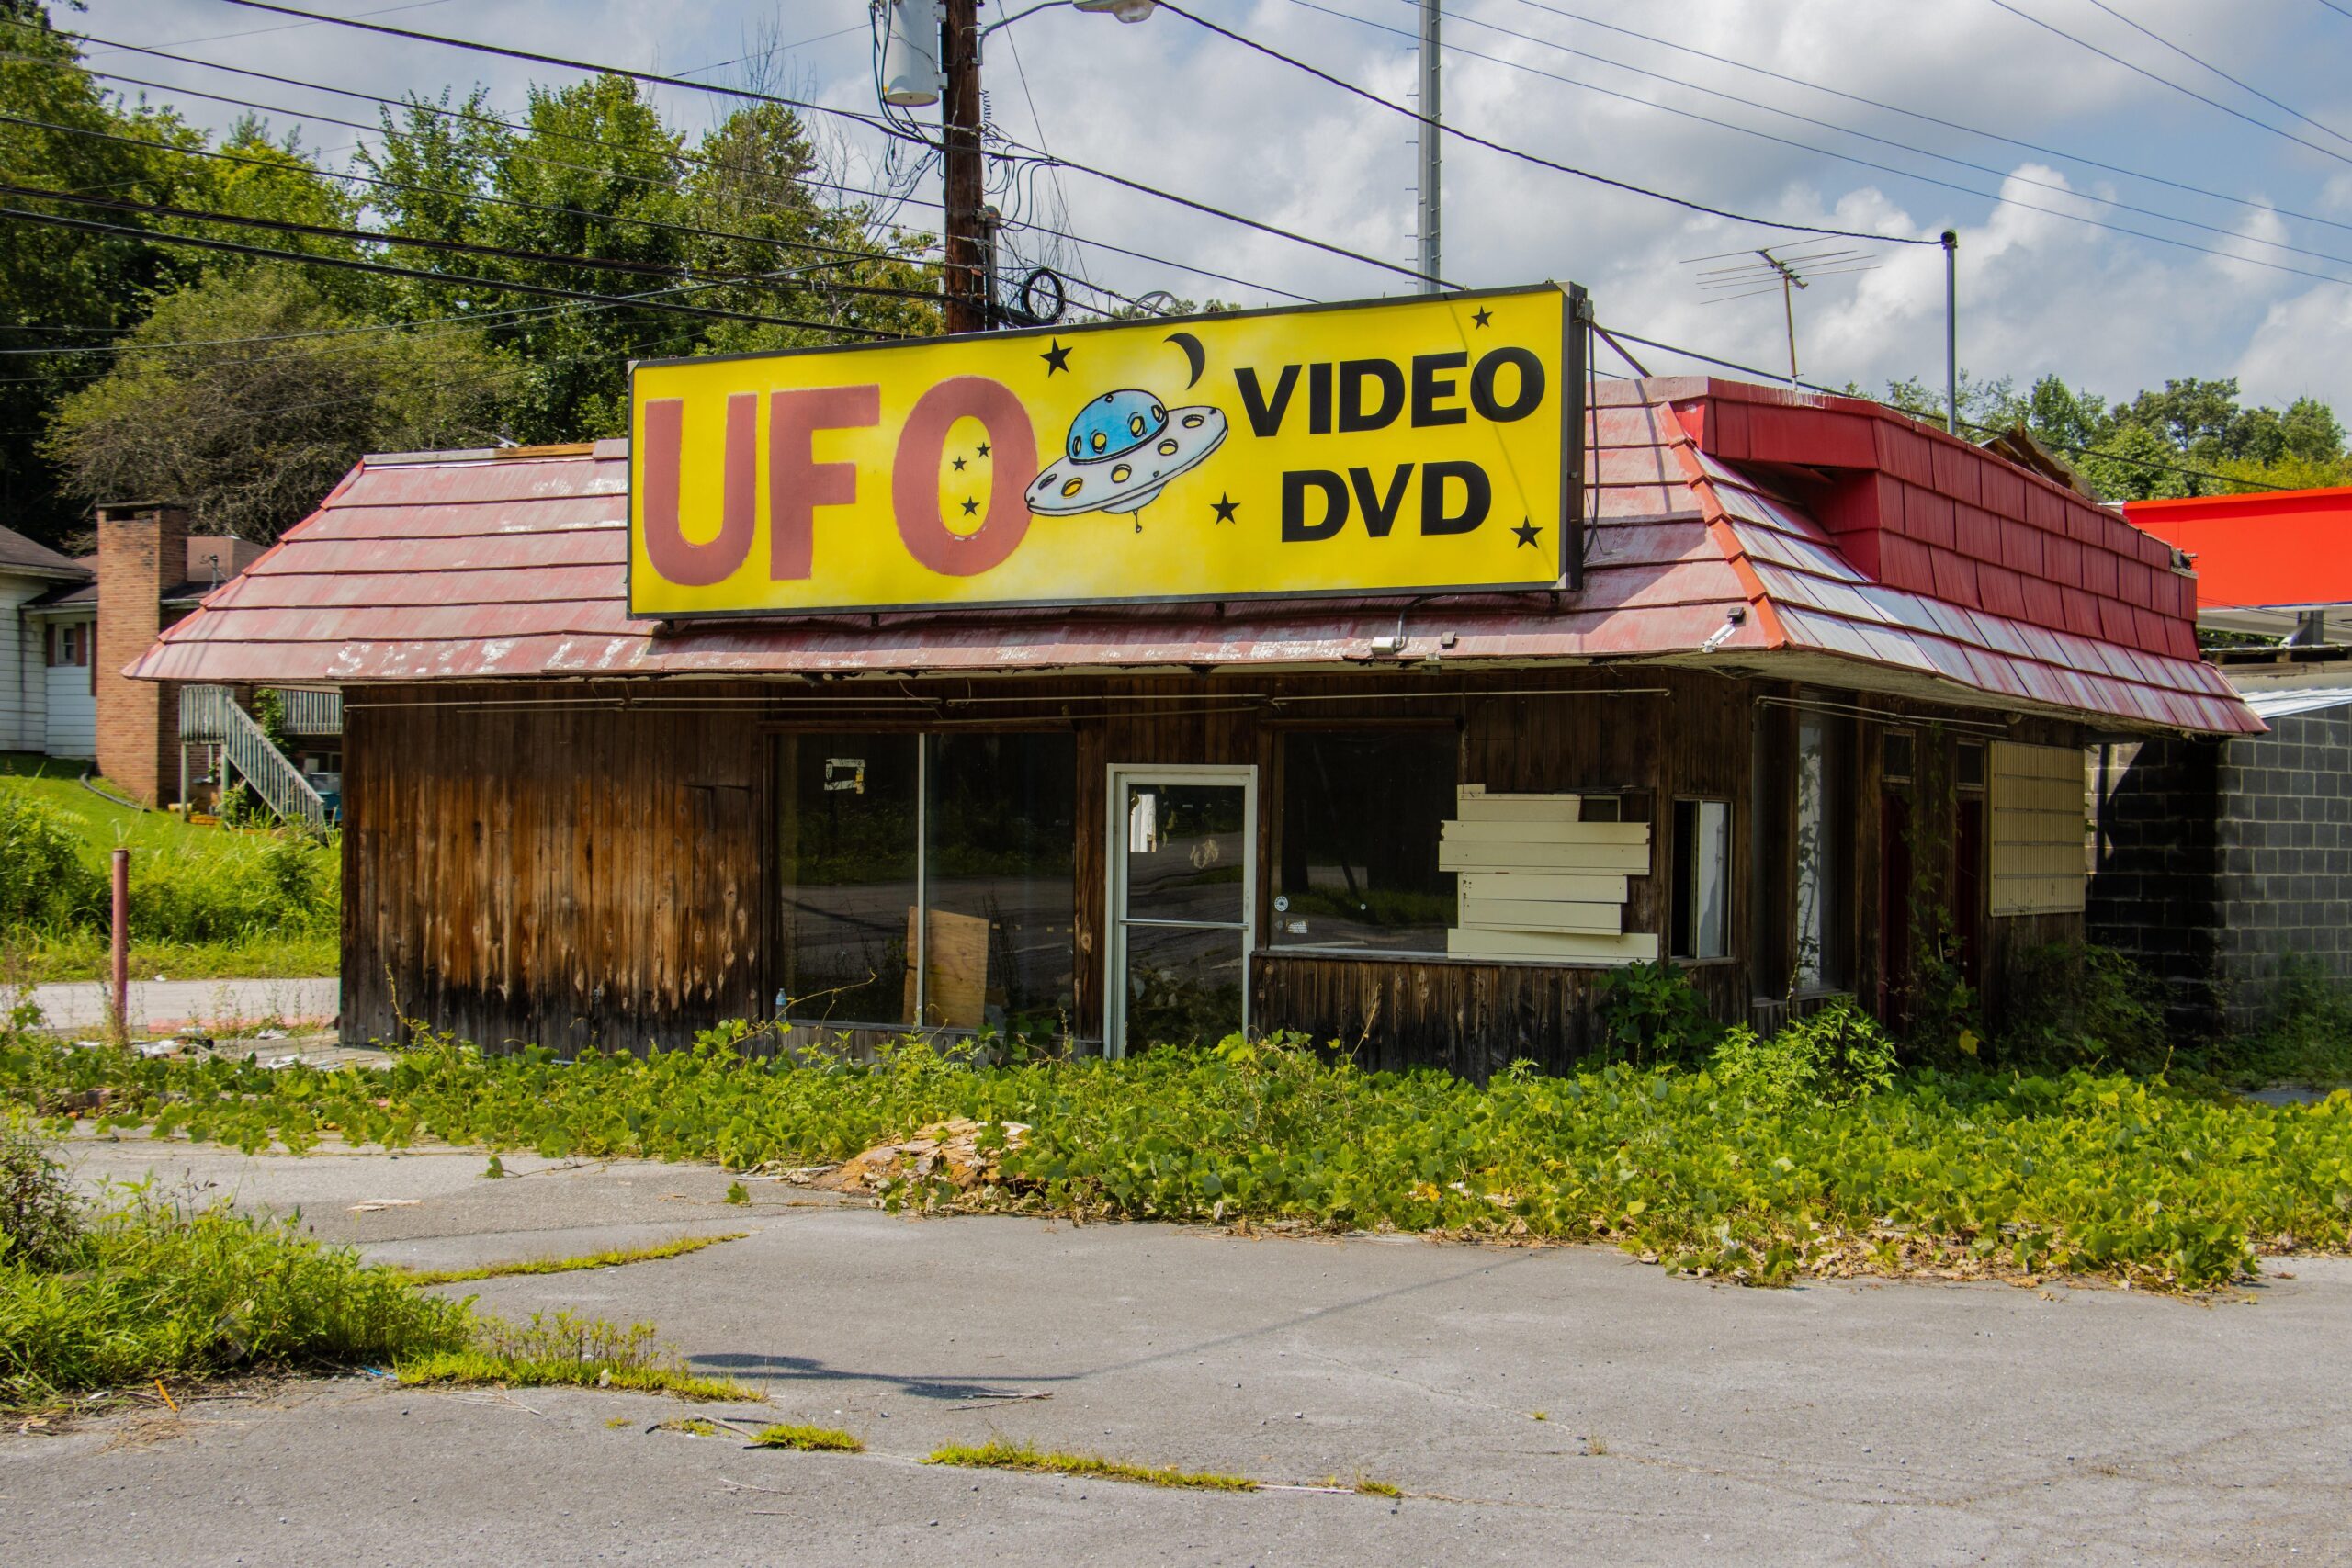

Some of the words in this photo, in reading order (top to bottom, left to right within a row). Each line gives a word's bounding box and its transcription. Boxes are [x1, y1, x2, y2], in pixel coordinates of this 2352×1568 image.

[1234, 346, 1545, 437] VIDEO
[643, 375, 1038, 587] UFO
[1282, 460, 1492, 543] DVD
